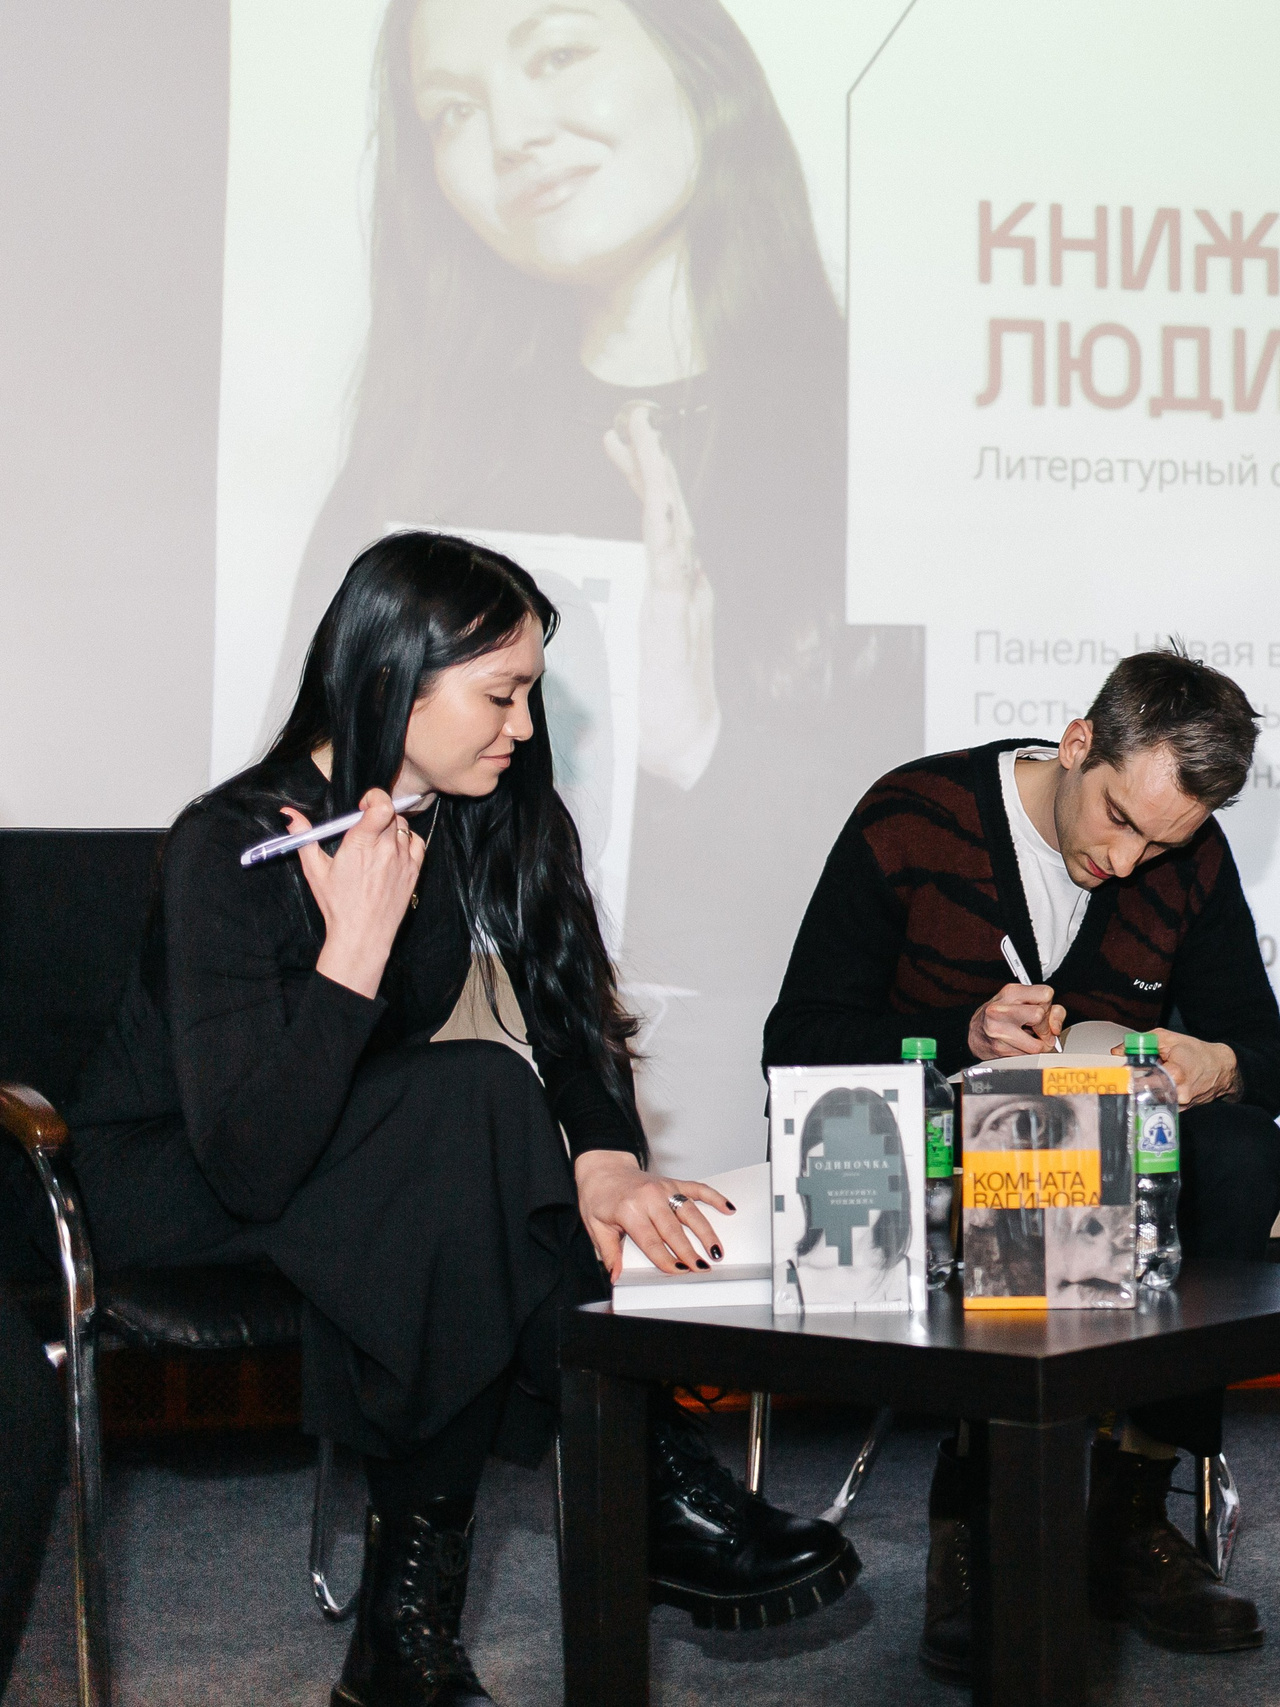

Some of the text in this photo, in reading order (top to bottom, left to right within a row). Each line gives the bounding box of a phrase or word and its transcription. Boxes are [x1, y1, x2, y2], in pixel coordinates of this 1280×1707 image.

[973, 446, 1259, 494] Литературный
[974, 629, 1121, 666] Панель
[974, 690, 1092, 726] Гость
[1047, 1072, 1098, 1085] АНТОН
[814, 1160, 890, 1171] ОДИНОЧКА
[973, 1171, 1086, 1191] КОМНАТА
